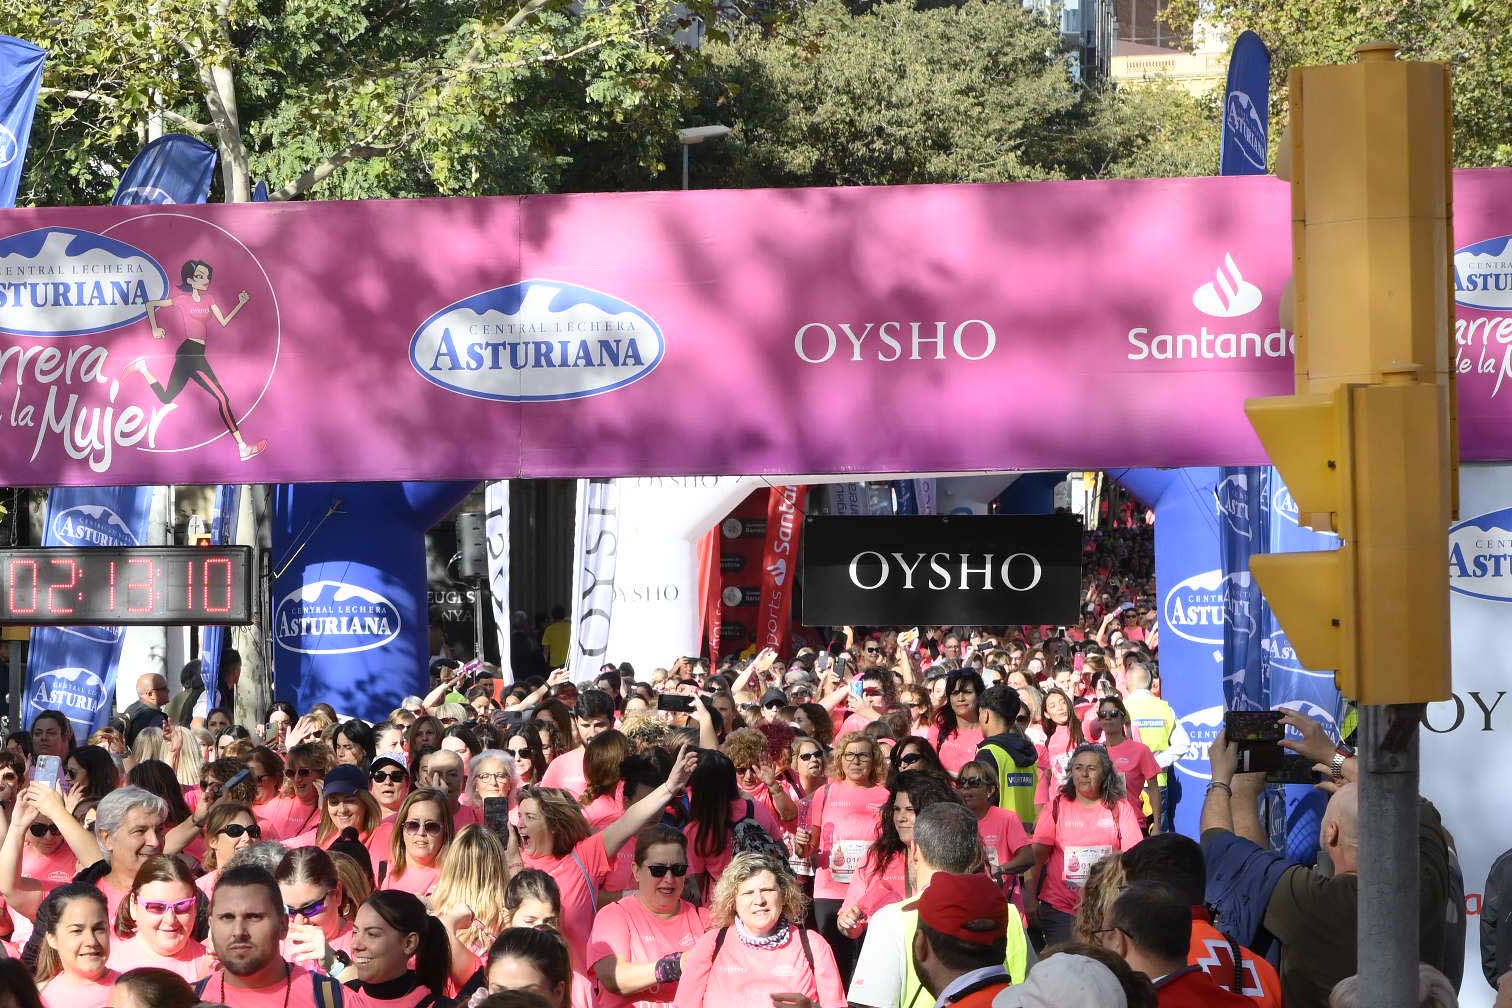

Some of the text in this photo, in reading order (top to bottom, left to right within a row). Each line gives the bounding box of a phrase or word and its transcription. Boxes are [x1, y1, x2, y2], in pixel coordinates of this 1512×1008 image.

[71, 262, 144, 275] LECHERA
[468, 320, 636, 336] CENTRAL LECHERA
[794, 319, 996, 364] OYSHO
[1127, 326, 1294, 361] Santand
[429, 327, 645, 371] ASTURIANA
[9, 386, 35, 428] la
[29, 378, 180, 473] Mujer
[58, 515, 129, 548] ASTURIA
[1474, 539, 1512, 549] CENT
[578, 478, 618, 657] OYSH
[848, 550, 1042, 592] OYSHO
[616, 583, 679, 601] YSHO
[1188, 595, 1224, 603] CENTR
[278, 610, 392, 639] ASTURIANA
[34, 680, 98, 712] ASTURIA
[1190, 730, 1217, 738] CENT
